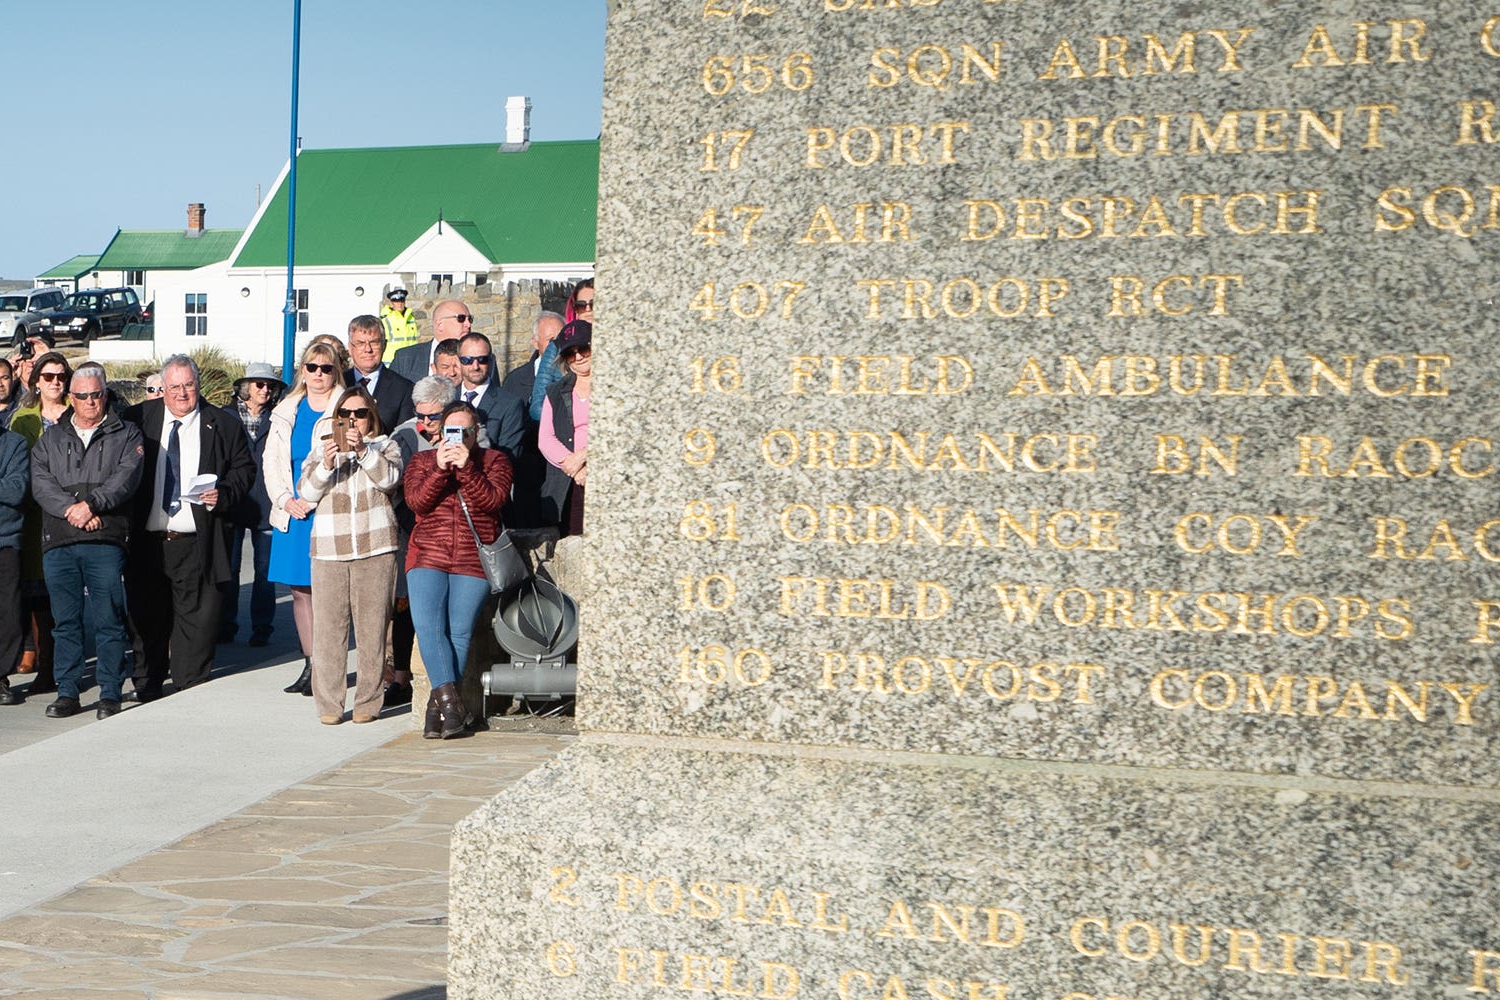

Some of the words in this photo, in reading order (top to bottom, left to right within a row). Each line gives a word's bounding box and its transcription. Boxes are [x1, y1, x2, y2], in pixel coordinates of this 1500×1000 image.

[702, 52, 814, 95] 656
[868, 42, 1004, 91] SQN
[1039, 28, 1256, 79] ARMY
[1293, 18, 1431, 68] AIR
[701, 130, 753, 170] 17
[806, 121, 971, 168] PORT
[1017, 103, 1398, 160] REGIMENT
[693, 205, 764, 248] 47
[799, 201, 917, 245] AIR
[963, 190, 1325, 240] DESPATCH
[690, 280, 805, 320] 407
[857, 277, 1069, 318] TROOP
[1107, 274, 1243, 316] RCT
[691, 356, 741, 394] 16
[790, 355, 973, 396] FIELD
[1009, 353, 1453, 397] AMBULANCE
[685, 428, 716, 466] 9
[763, 429, 1097, 474] ORDNANCE
[1151, 434, 1243, 475] BN
[1296, 435, 1495, 479] RAOC
[680, 500, 741, 542] 81
[780, 503, 1121, 549] ORDNANCE
[1174, 512, 1318, 556] COY
[678, 574, 736, 610] 10
[780, 576, 951, 620] FIELD
[996, 583, 1413, 640] WORKSHOPS
[678, 646, 772, 685] 160
[822, 652, 1105, 703] PROVOST
[1150, 669, 1489, 724] COMPANY
[550, 867, 580, 905] 2
[616, 874, 848, 931] POSTAL
[879, 900, 1025, 947] AND
[1071, 916, 1409, 984] COURIER
[547, 942, 576, 976] 6
[617, 948, 799, 998] FIELD
